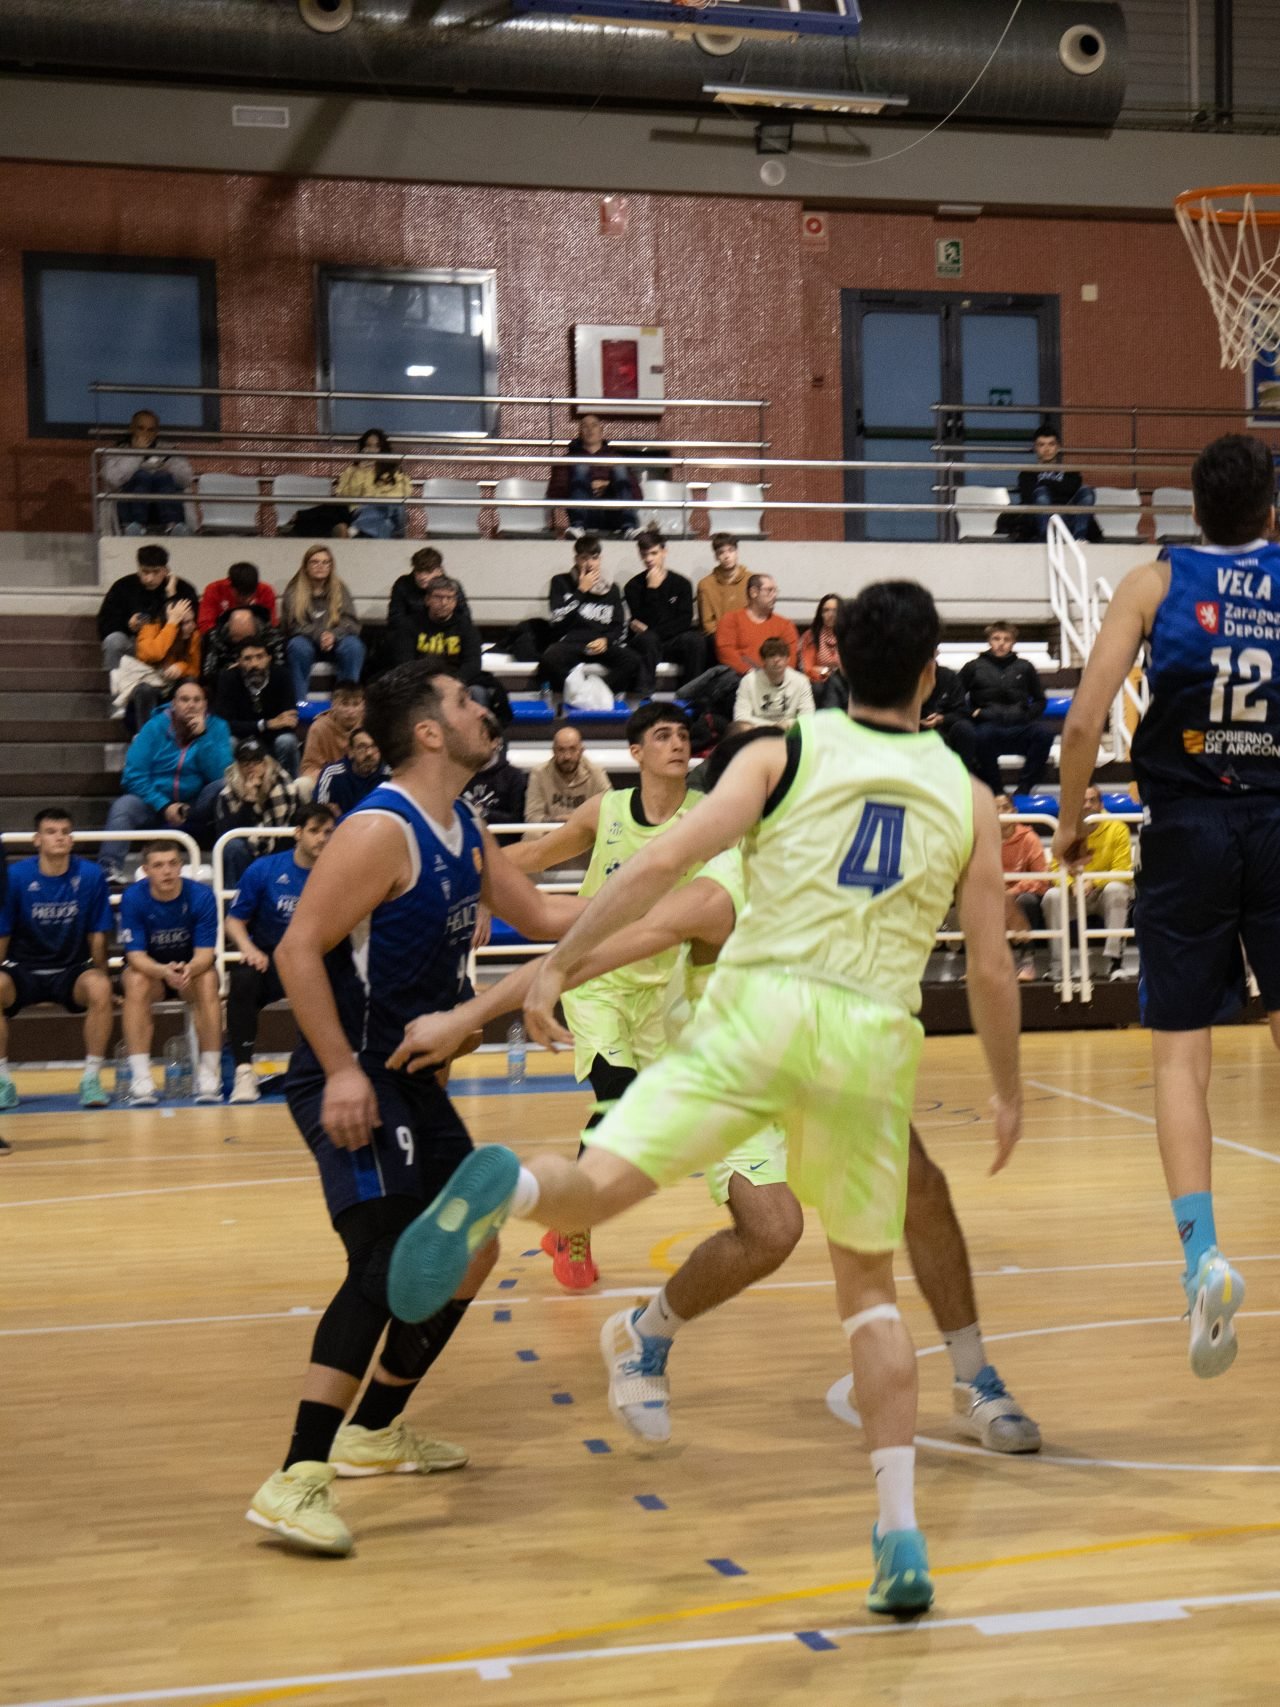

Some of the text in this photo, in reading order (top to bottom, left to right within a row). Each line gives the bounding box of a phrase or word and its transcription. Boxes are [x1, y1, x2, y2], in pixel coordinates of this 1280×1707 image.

[1217, 567, 1272, 600] VELA
[1209, 646, 1272, 722] 12
[1205, 730, 1273, 745] GOBIERNO
[1205, 741, 1222, 754] DE
[838, 801, 905, 898] 4
[396, 1126, 414, 1166] 9
